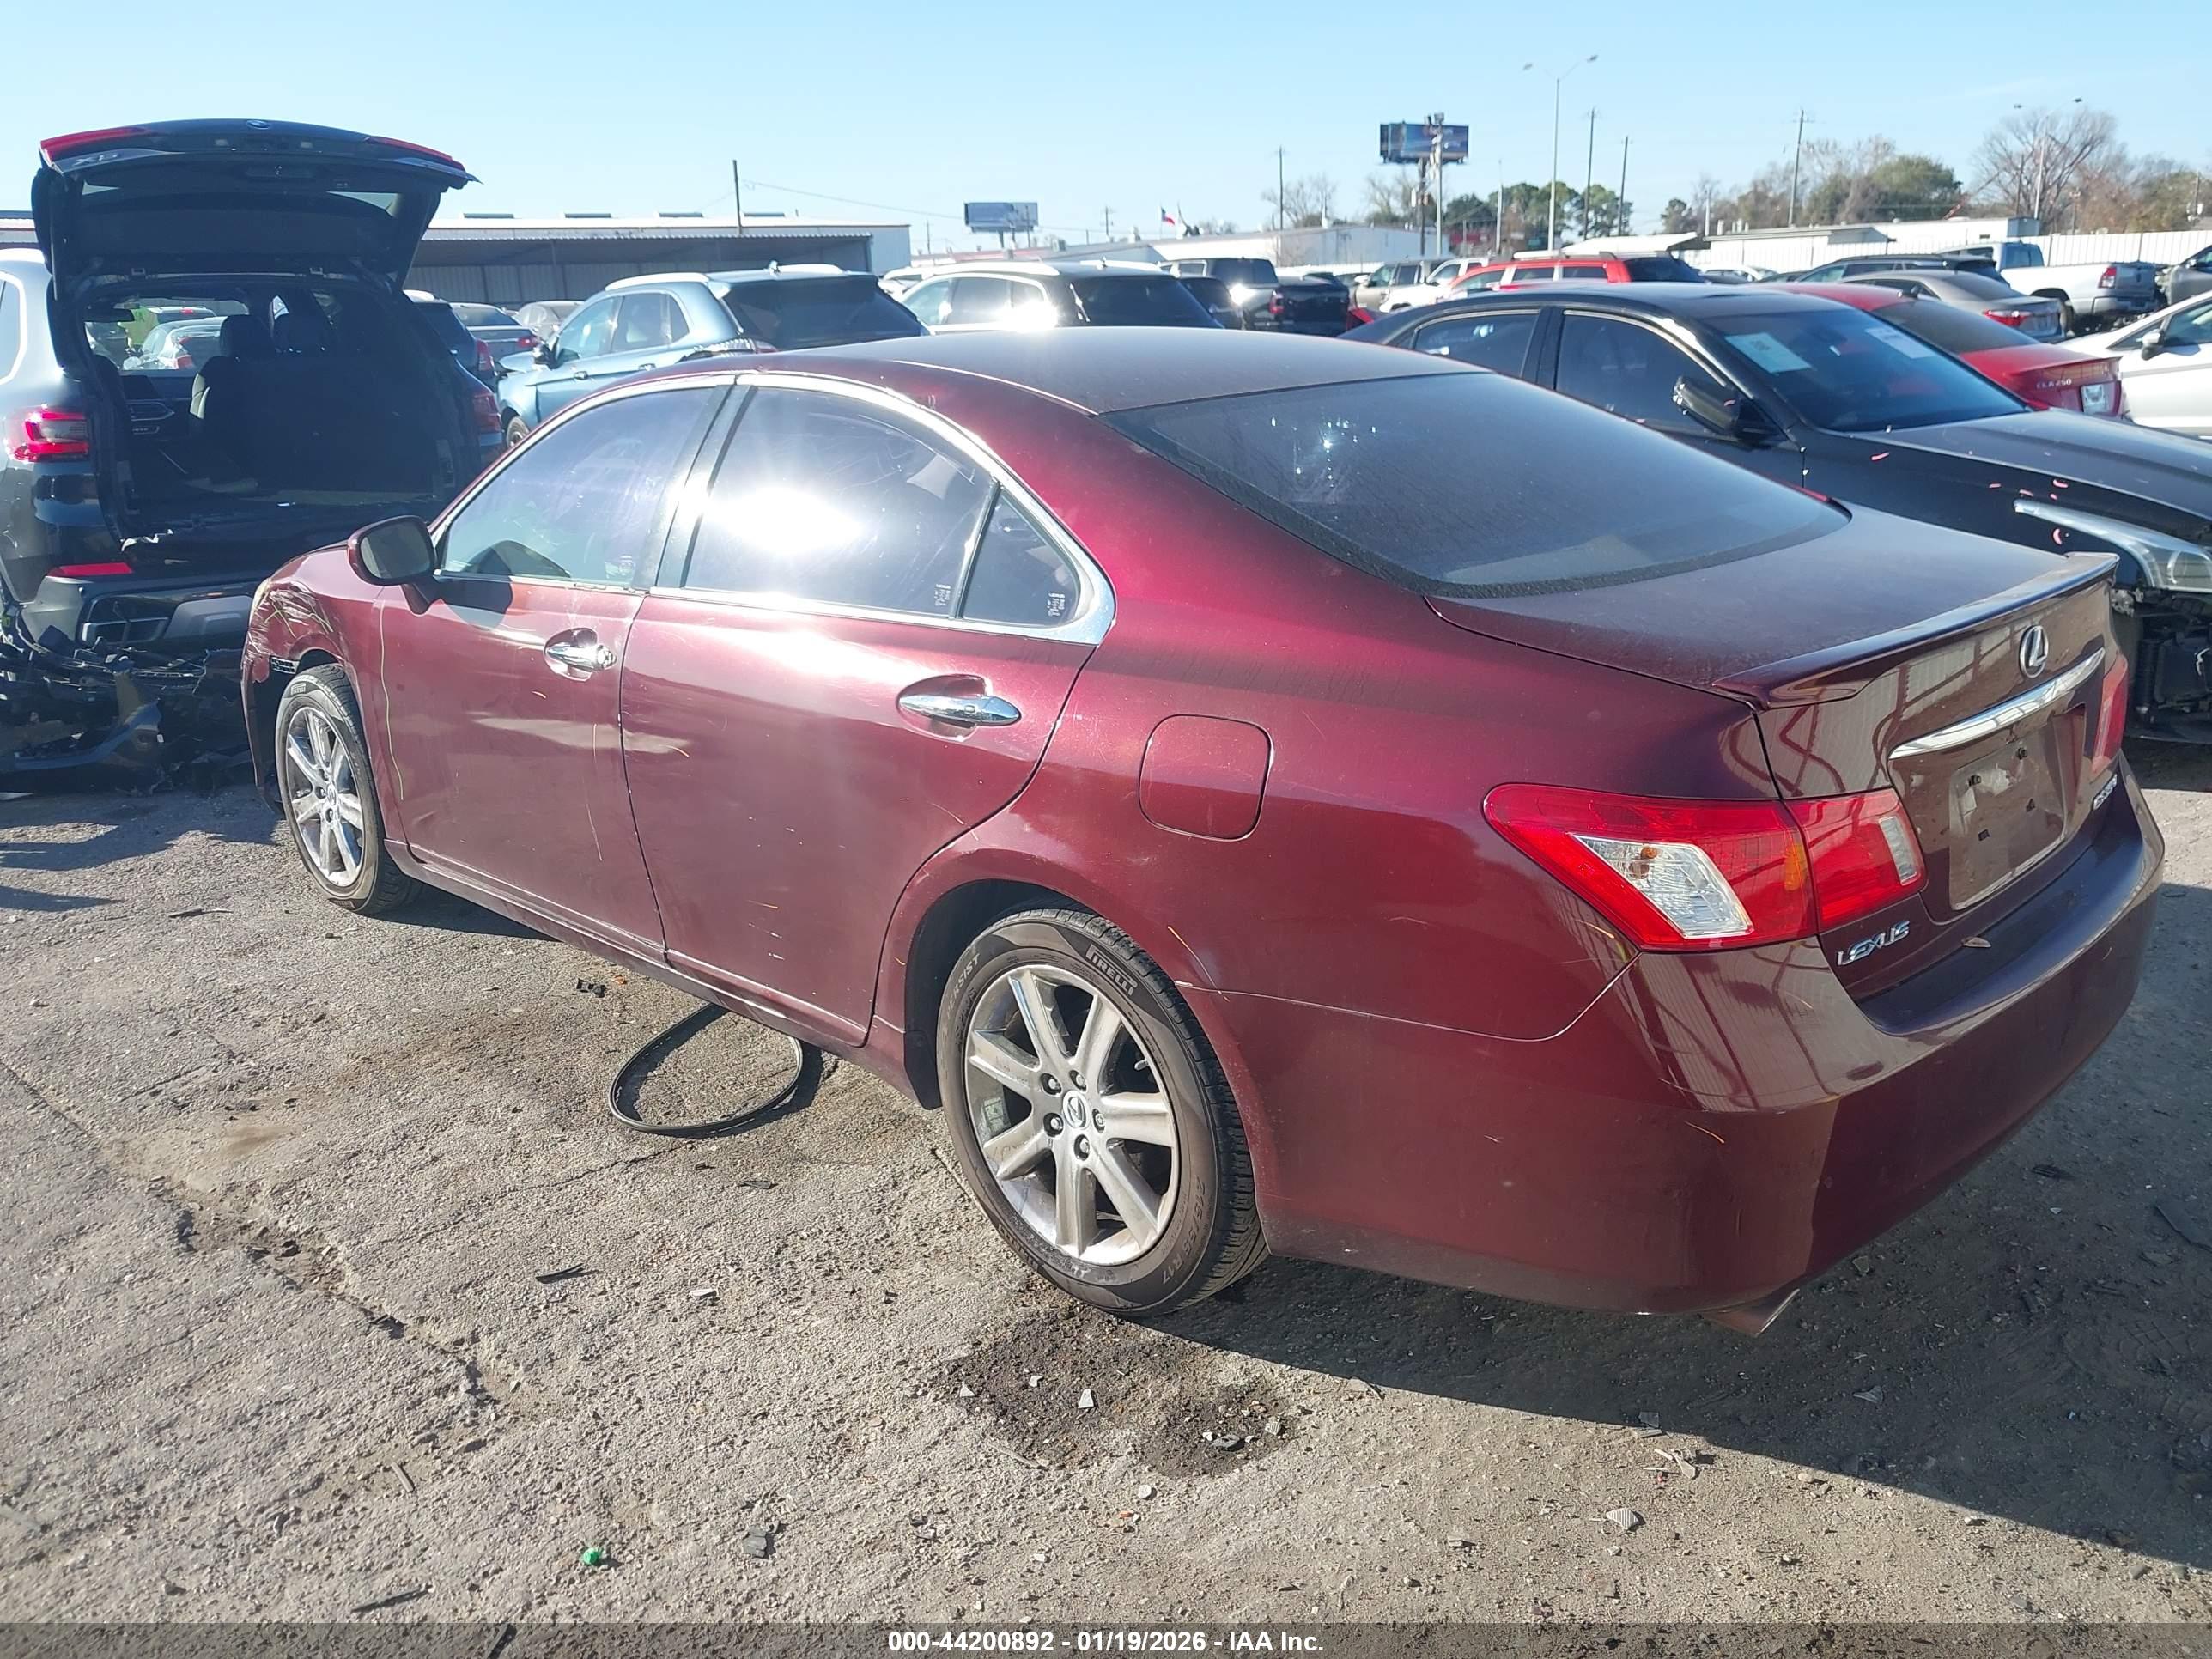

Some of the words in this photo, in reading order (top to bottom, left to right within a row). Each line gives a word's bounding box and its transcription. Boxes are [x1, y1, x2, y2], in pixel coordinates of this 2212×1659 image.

[1838, 920, 1910, 965] LEXUS
[1085, 944, 1138, 996] PIRELLI
[1183, 1174, 1206, 1255] 215/55
[1163, 1253, 1184, 1285] R17
